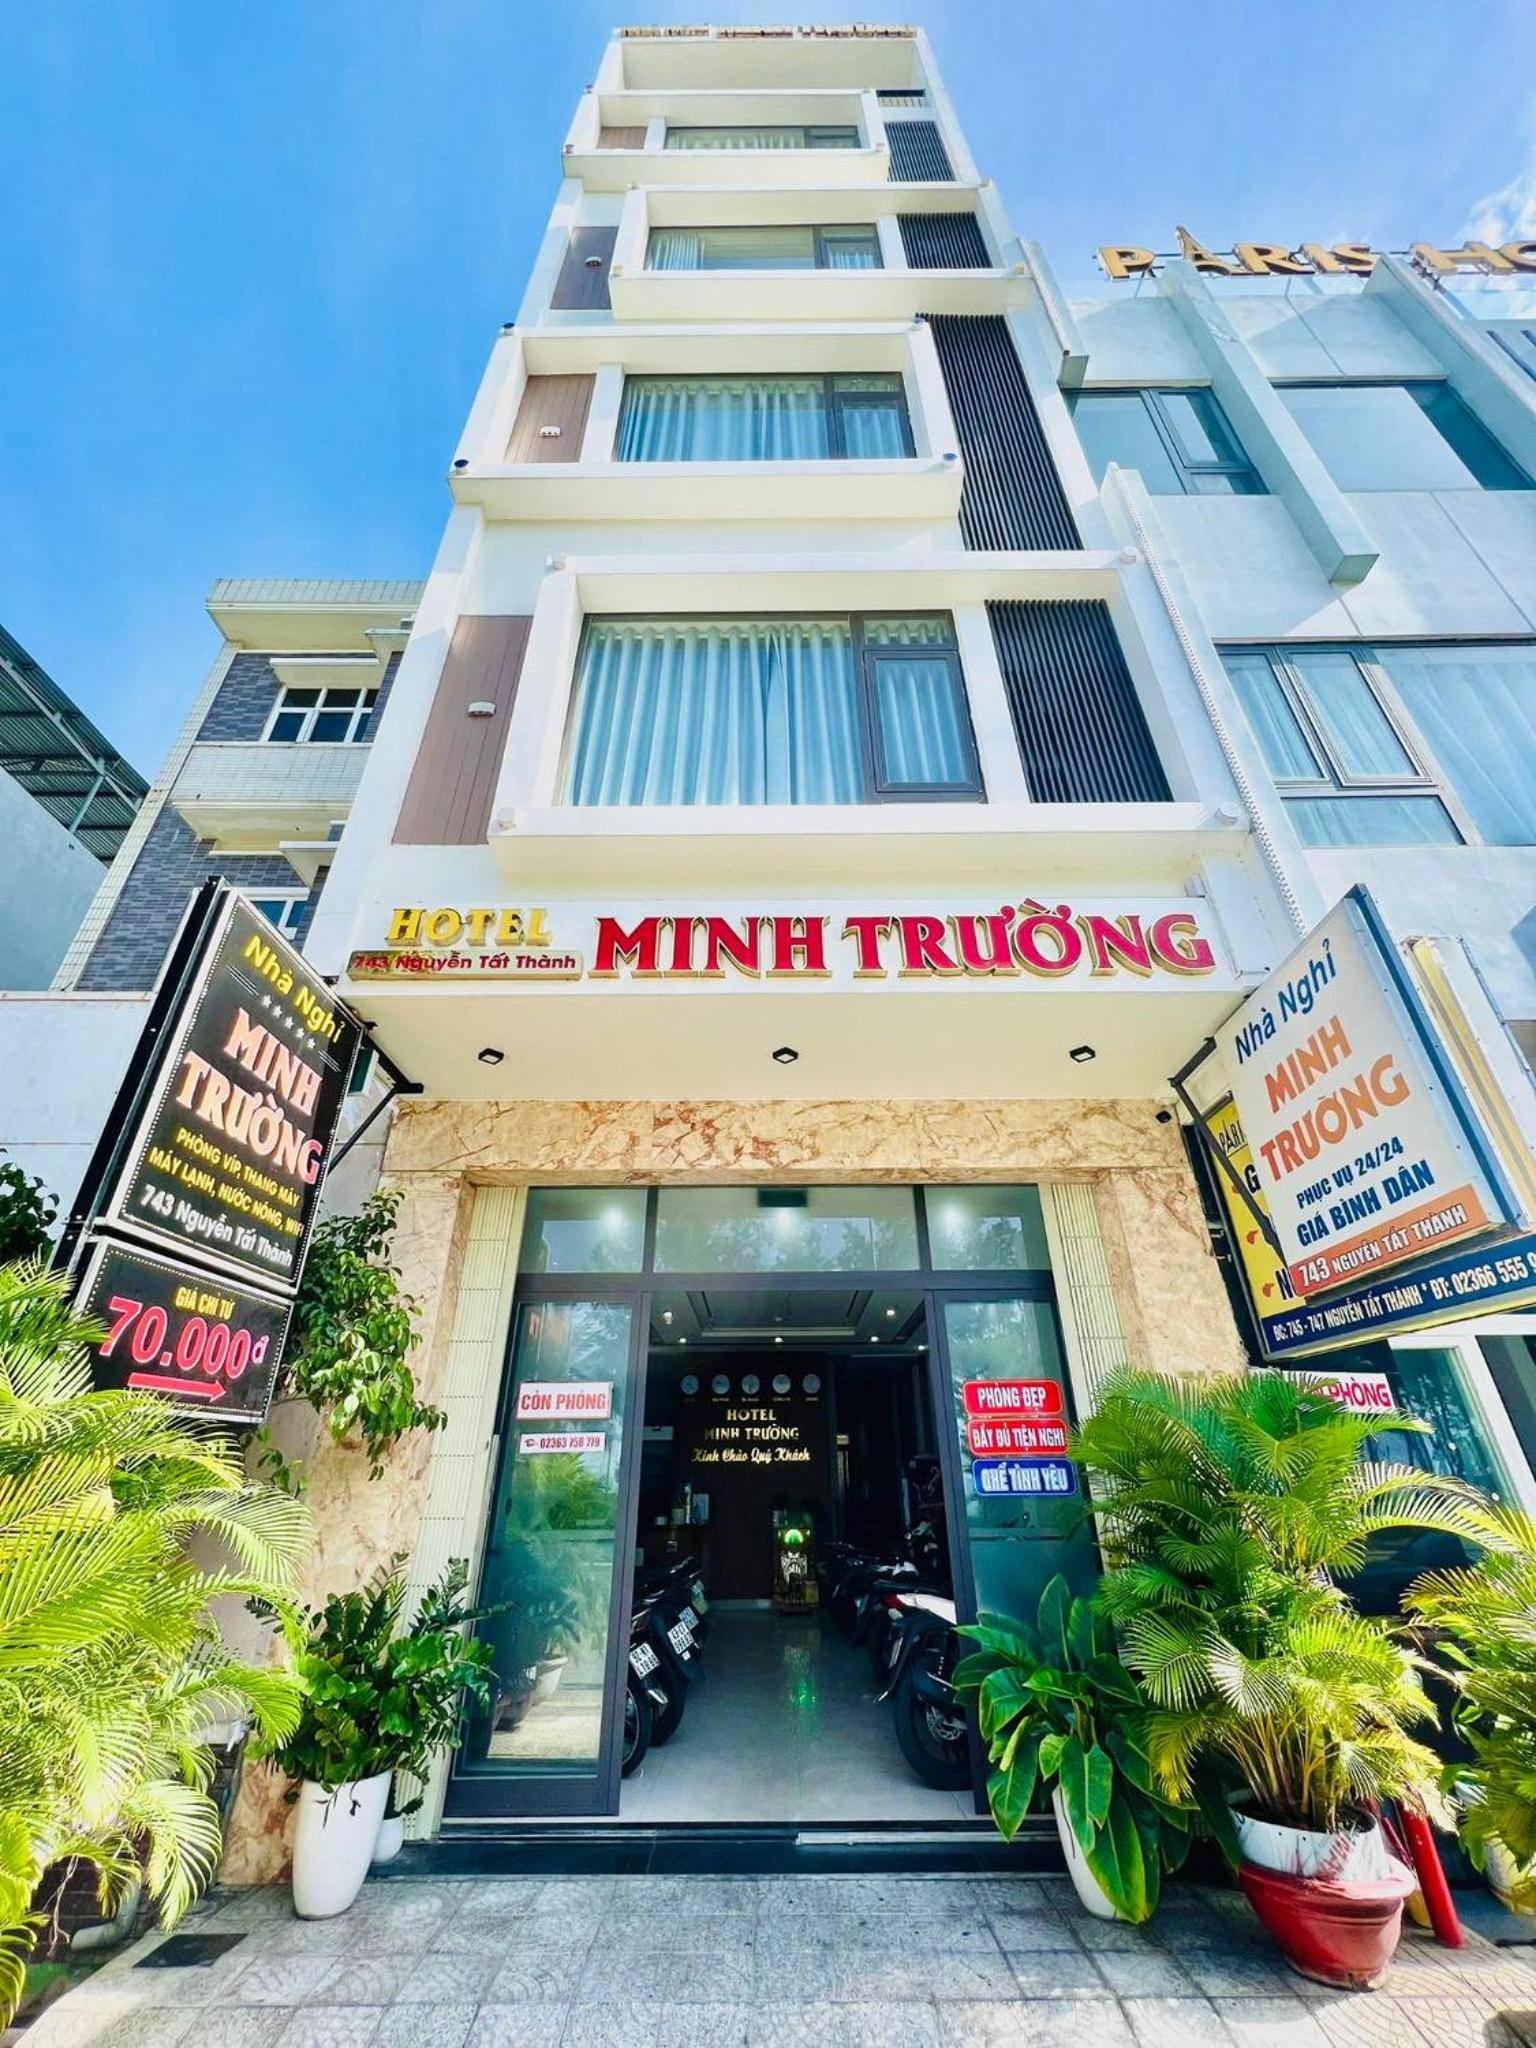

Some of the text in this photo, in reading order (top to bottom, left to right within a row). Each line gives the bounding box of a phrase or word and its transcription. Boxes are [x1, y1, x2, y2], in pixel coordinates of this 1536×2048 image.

[1097, 224, 1376, 280] PARIS
[385, 908, 553, 946] HOTEL
[588, 898, 1217, 979] MINH TRƯỜNG
[244, 935, 345, 1043] Nhà Nghỉ
[353, 950, 576, 973] 743 Nguyễn Tất Thành
[1235, 938, 1336, 1064] Nhà Nghỉ
[223, 1006, 323, 1117] MINH
[1264, 1014, 1352, 1114] MINH
[176, 1049, 323, 1185] TRƯỜNG
[148, 1146, 182, 1175] MÁY
[176, 1127, 221, 1164] PHÒNG
[243, 1164, 278, 1196] THANG
[278, 1187, 300, 1209] MÁY
[1296, 1136, 1404, 1210] PHỤC VỤ 24/24
[141, 1184, 175, 1216] 743
[175, 1199, 233, 1242] Nguyễn
[1296, 1159, 1436, 1247] GIÁ BÌNH DÂN
[175, 1286, 199, 1311] GIÁ
[1298, 1257, 1331, 1287] 743
[1381, 1285, 1423, 1312] THÀNH
[1451, 1265, 1498, 1294] 02366
[1495, 1256, 1529, 1283] 555
[727, 1408, 776, 1421] HOTEL
[977, 1382, 1047, 1411] PHÒNG ĐẸP
[704, 1427, 740, 1440] MINH
[1012, 1424, 1037, 1451] TIỆN
[1008, 1463, 1042, 1491] TÌNH
[1041, 1463, 1069, 1491] YÊU
